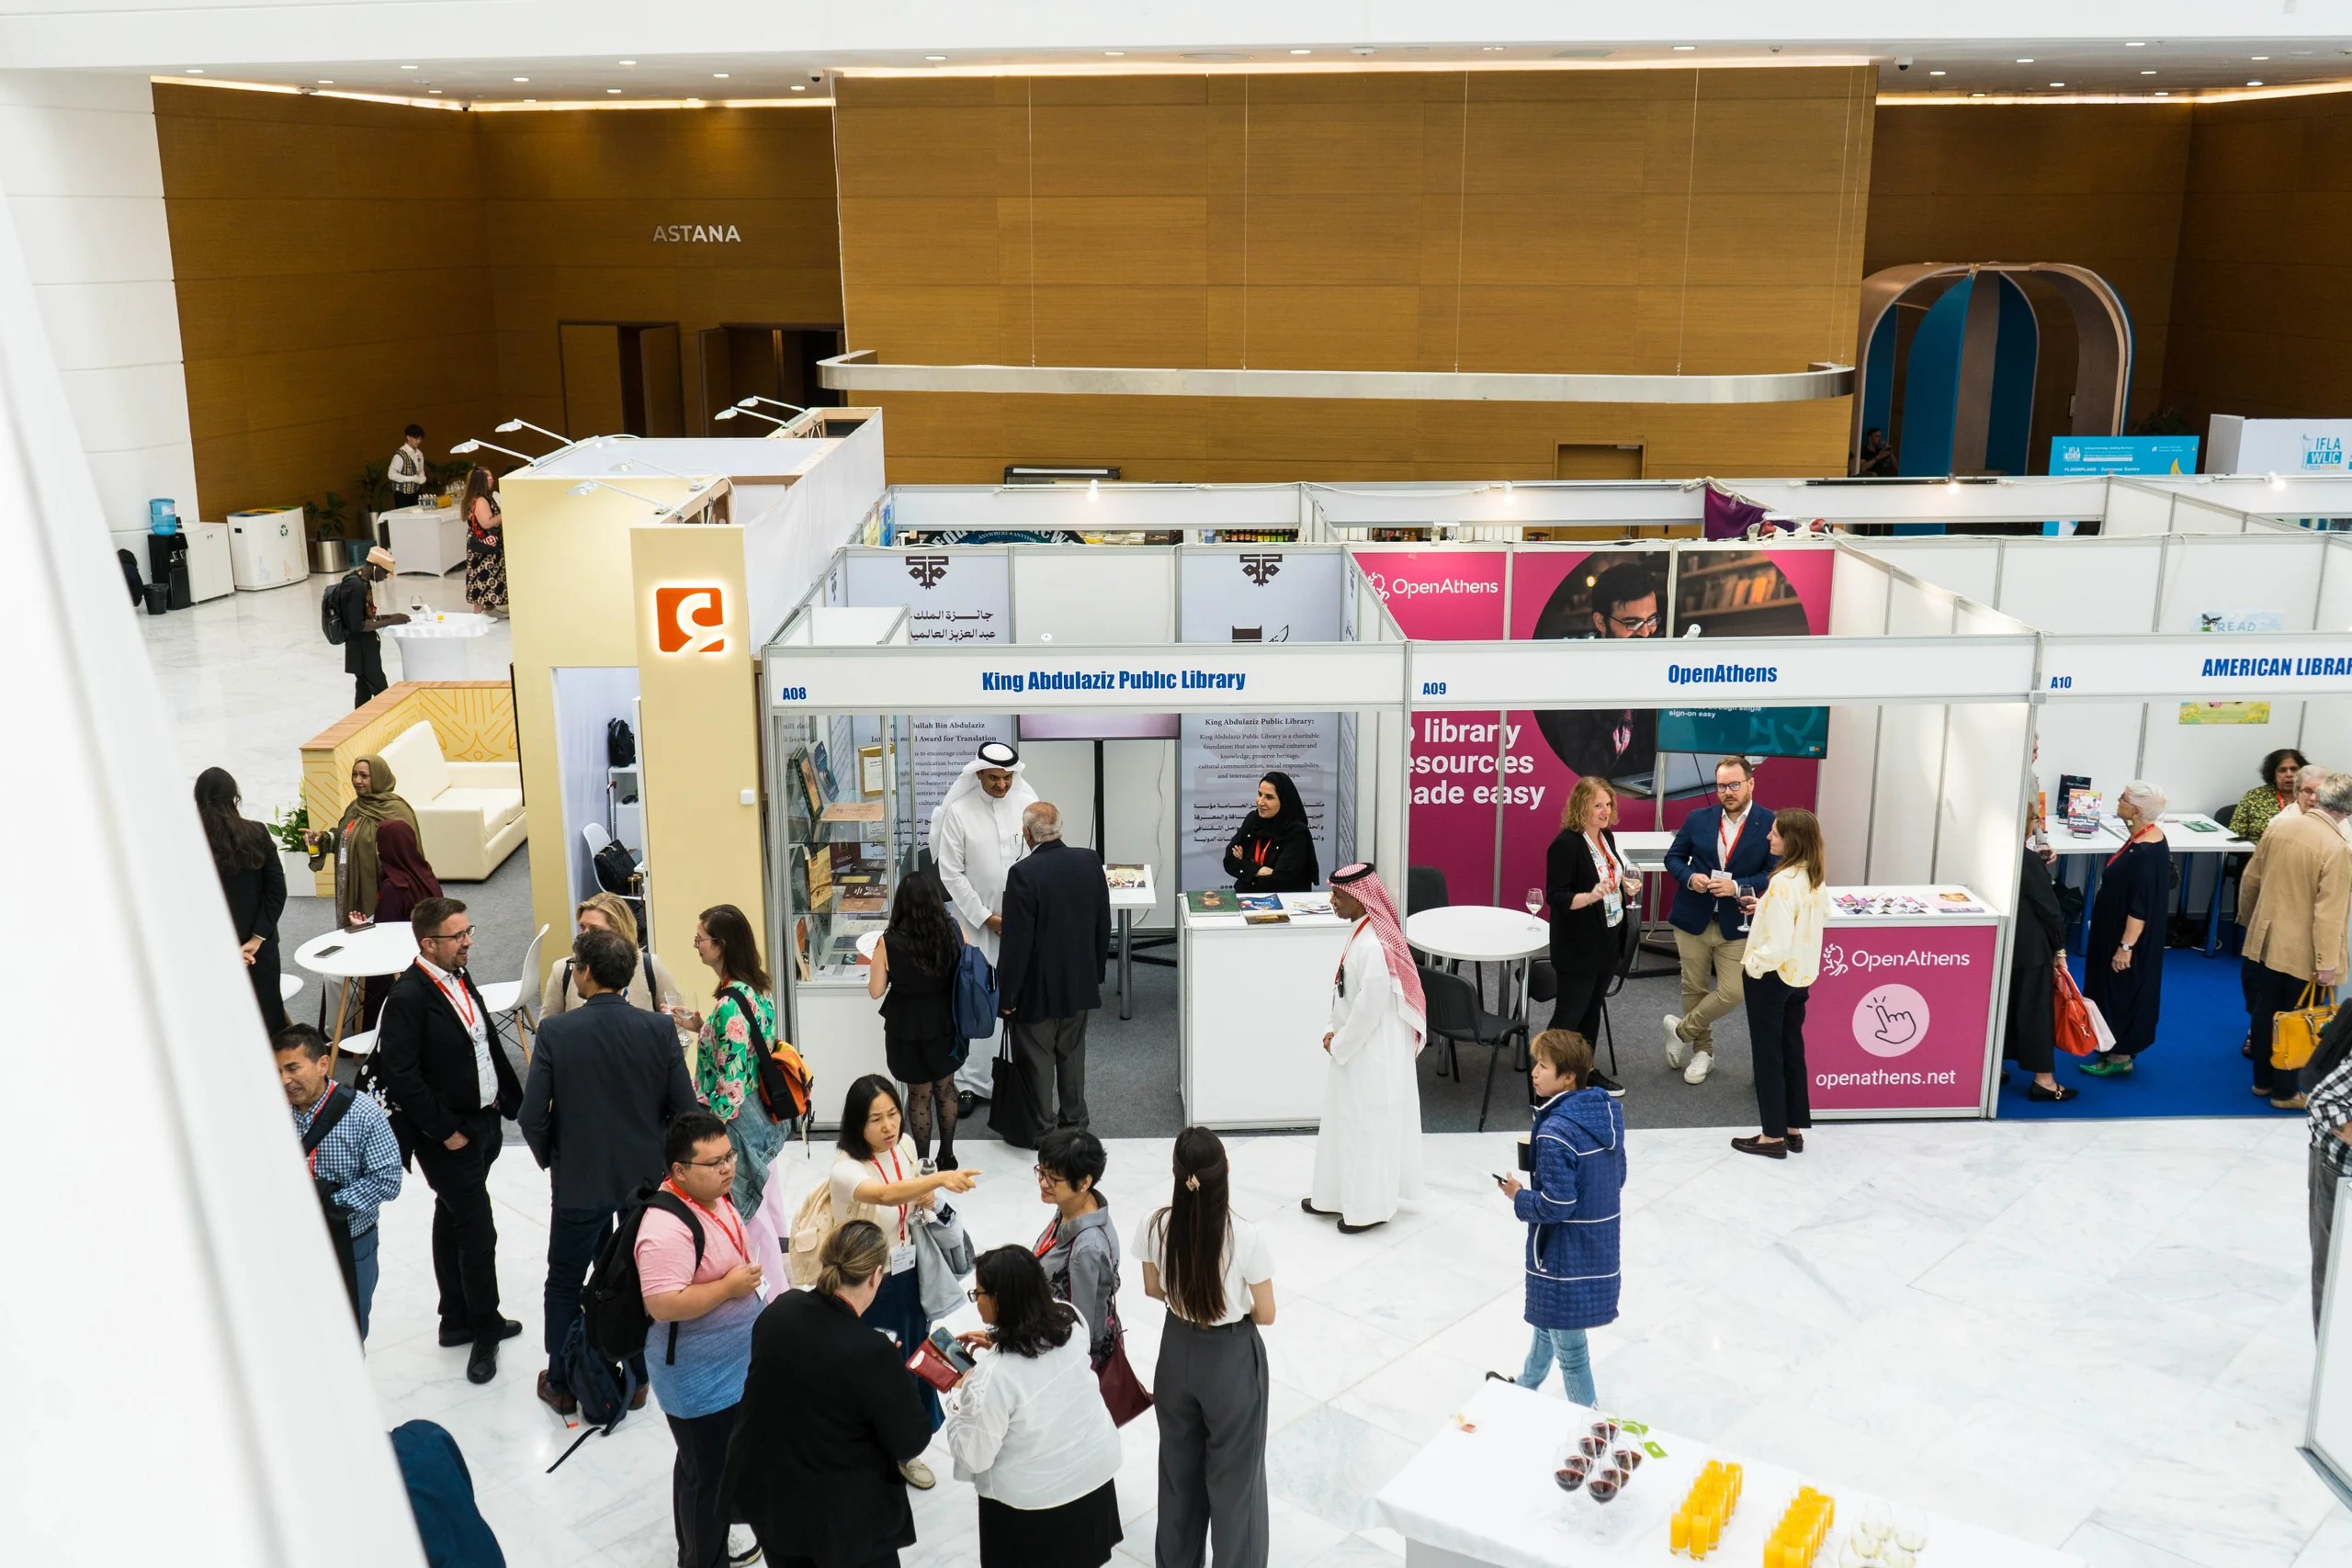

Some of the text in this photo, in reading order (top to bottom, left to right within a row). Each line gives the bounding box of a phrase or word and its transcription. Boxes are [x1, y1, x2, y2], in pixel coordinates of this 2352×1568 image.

[652, 224, 741, 243] ASTANA
[2315, 436, 2341, 451] IFLA
[2310, 451, 2342, 464] WLIC
[1392, 578, 1498, 598] OpenAthens
[910, 628, 947, 641] العالمي
[2217, 621, 2256, 632] READ
[1668, 664, 1778, 685] OpenAthens
[2201, 657, 2352, 677] AMERICAN LIBRA
[982, 671, 1246, 693] King Abdulaziz Public Library
[1422, 682, 1447, 695] A09
[2051, 676, 2072, 689] A10
[782, 687, 808, 701] A08
[1204, 718, 1223, 727] King
[1285, 717, 1315, 726] Library:
[1668, 709, 1697, 717] sign-on
[1425, 718, 1521, 749] library
[1410, 755, 1533, 773] sources
[1473, 785, 1546, 810] easy
[1851, 950, 1971, 972] OpenAthens
[1815, 1069, 1956, 1089] openathens.net
